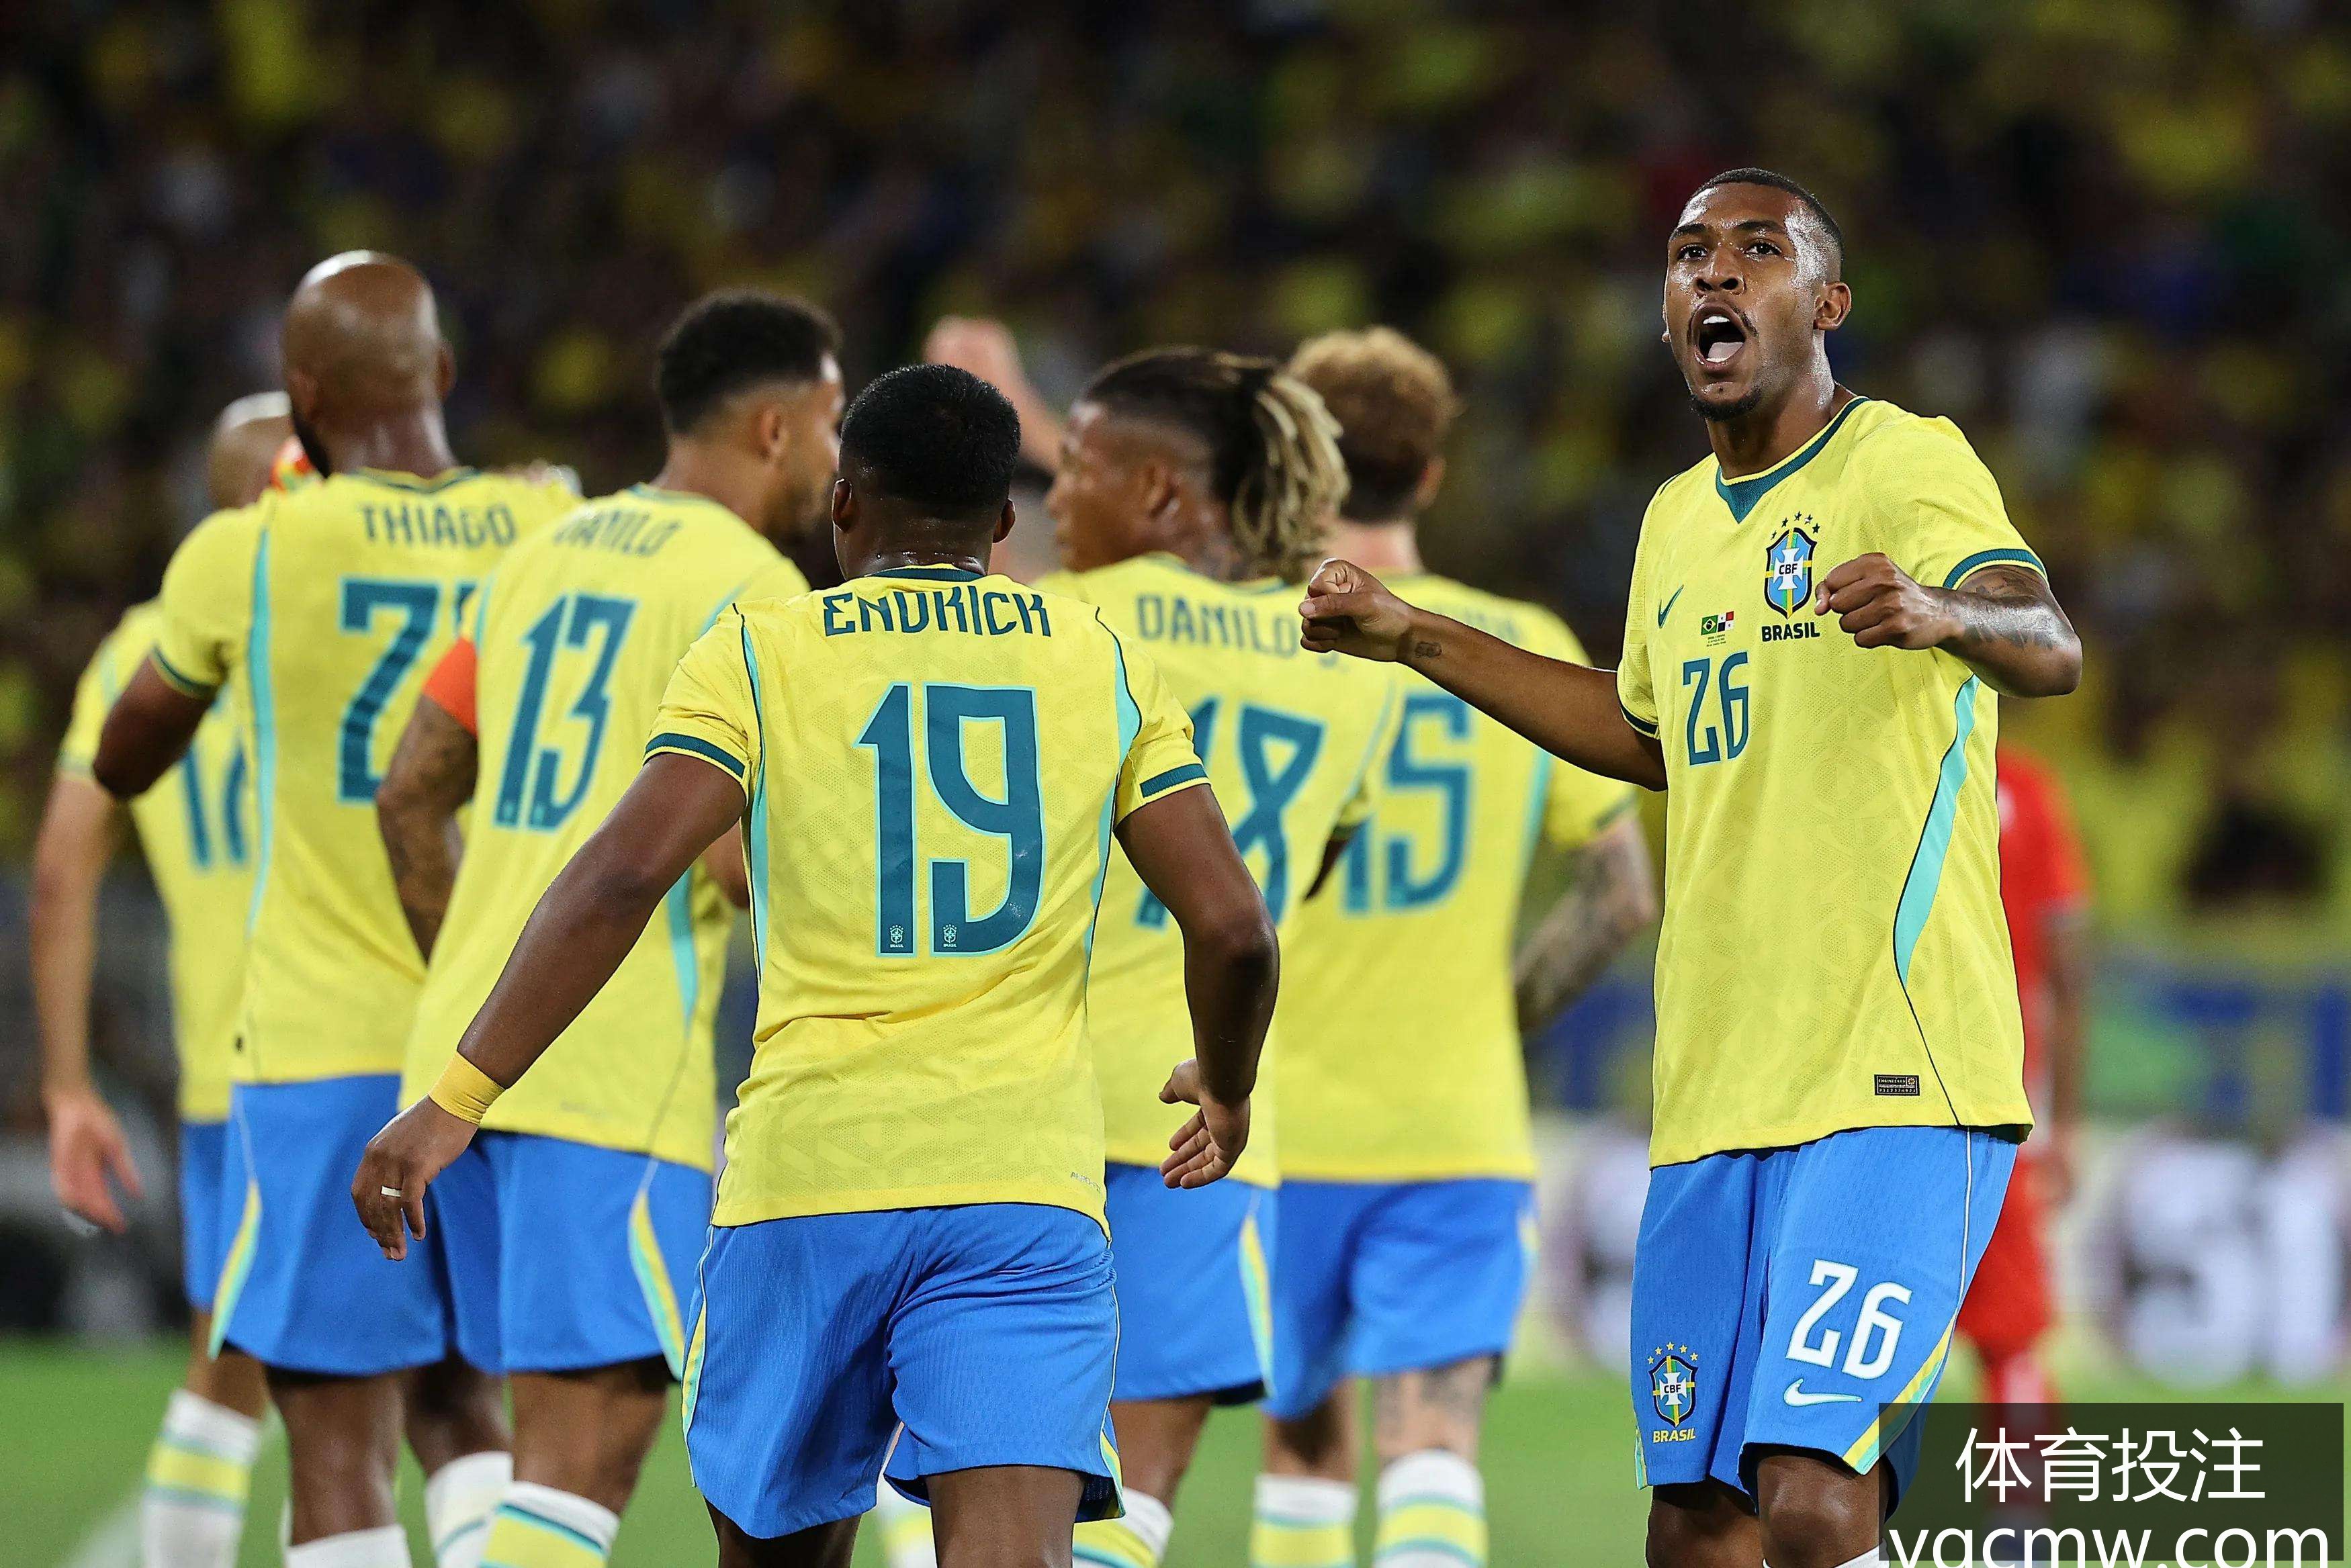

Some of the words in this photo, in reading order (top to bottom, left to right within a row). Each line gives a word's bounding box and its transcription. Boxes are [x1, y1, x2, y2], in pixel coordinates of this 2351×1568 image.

[359, 502, 517, 548] THIAGO
[1779, 563, 1798, 575] CBF
[823, 585, 1052, 637] ENDRICK
[1137, 594, 1300, 659] DANILO
[1761, 621, 1820, 643] BRASIL
[339, 576, 478, 803] 2
[490, 592, 639, 833] 13
[1682, 651, 1750, 767] 26
[853, 681, 1047, 957] 19
[1785, 1258, 1914, 1381] 26
[1663, 1382, 1682, 1395] CBF
[1652, 1426, 1697, 1444] BRASIL
